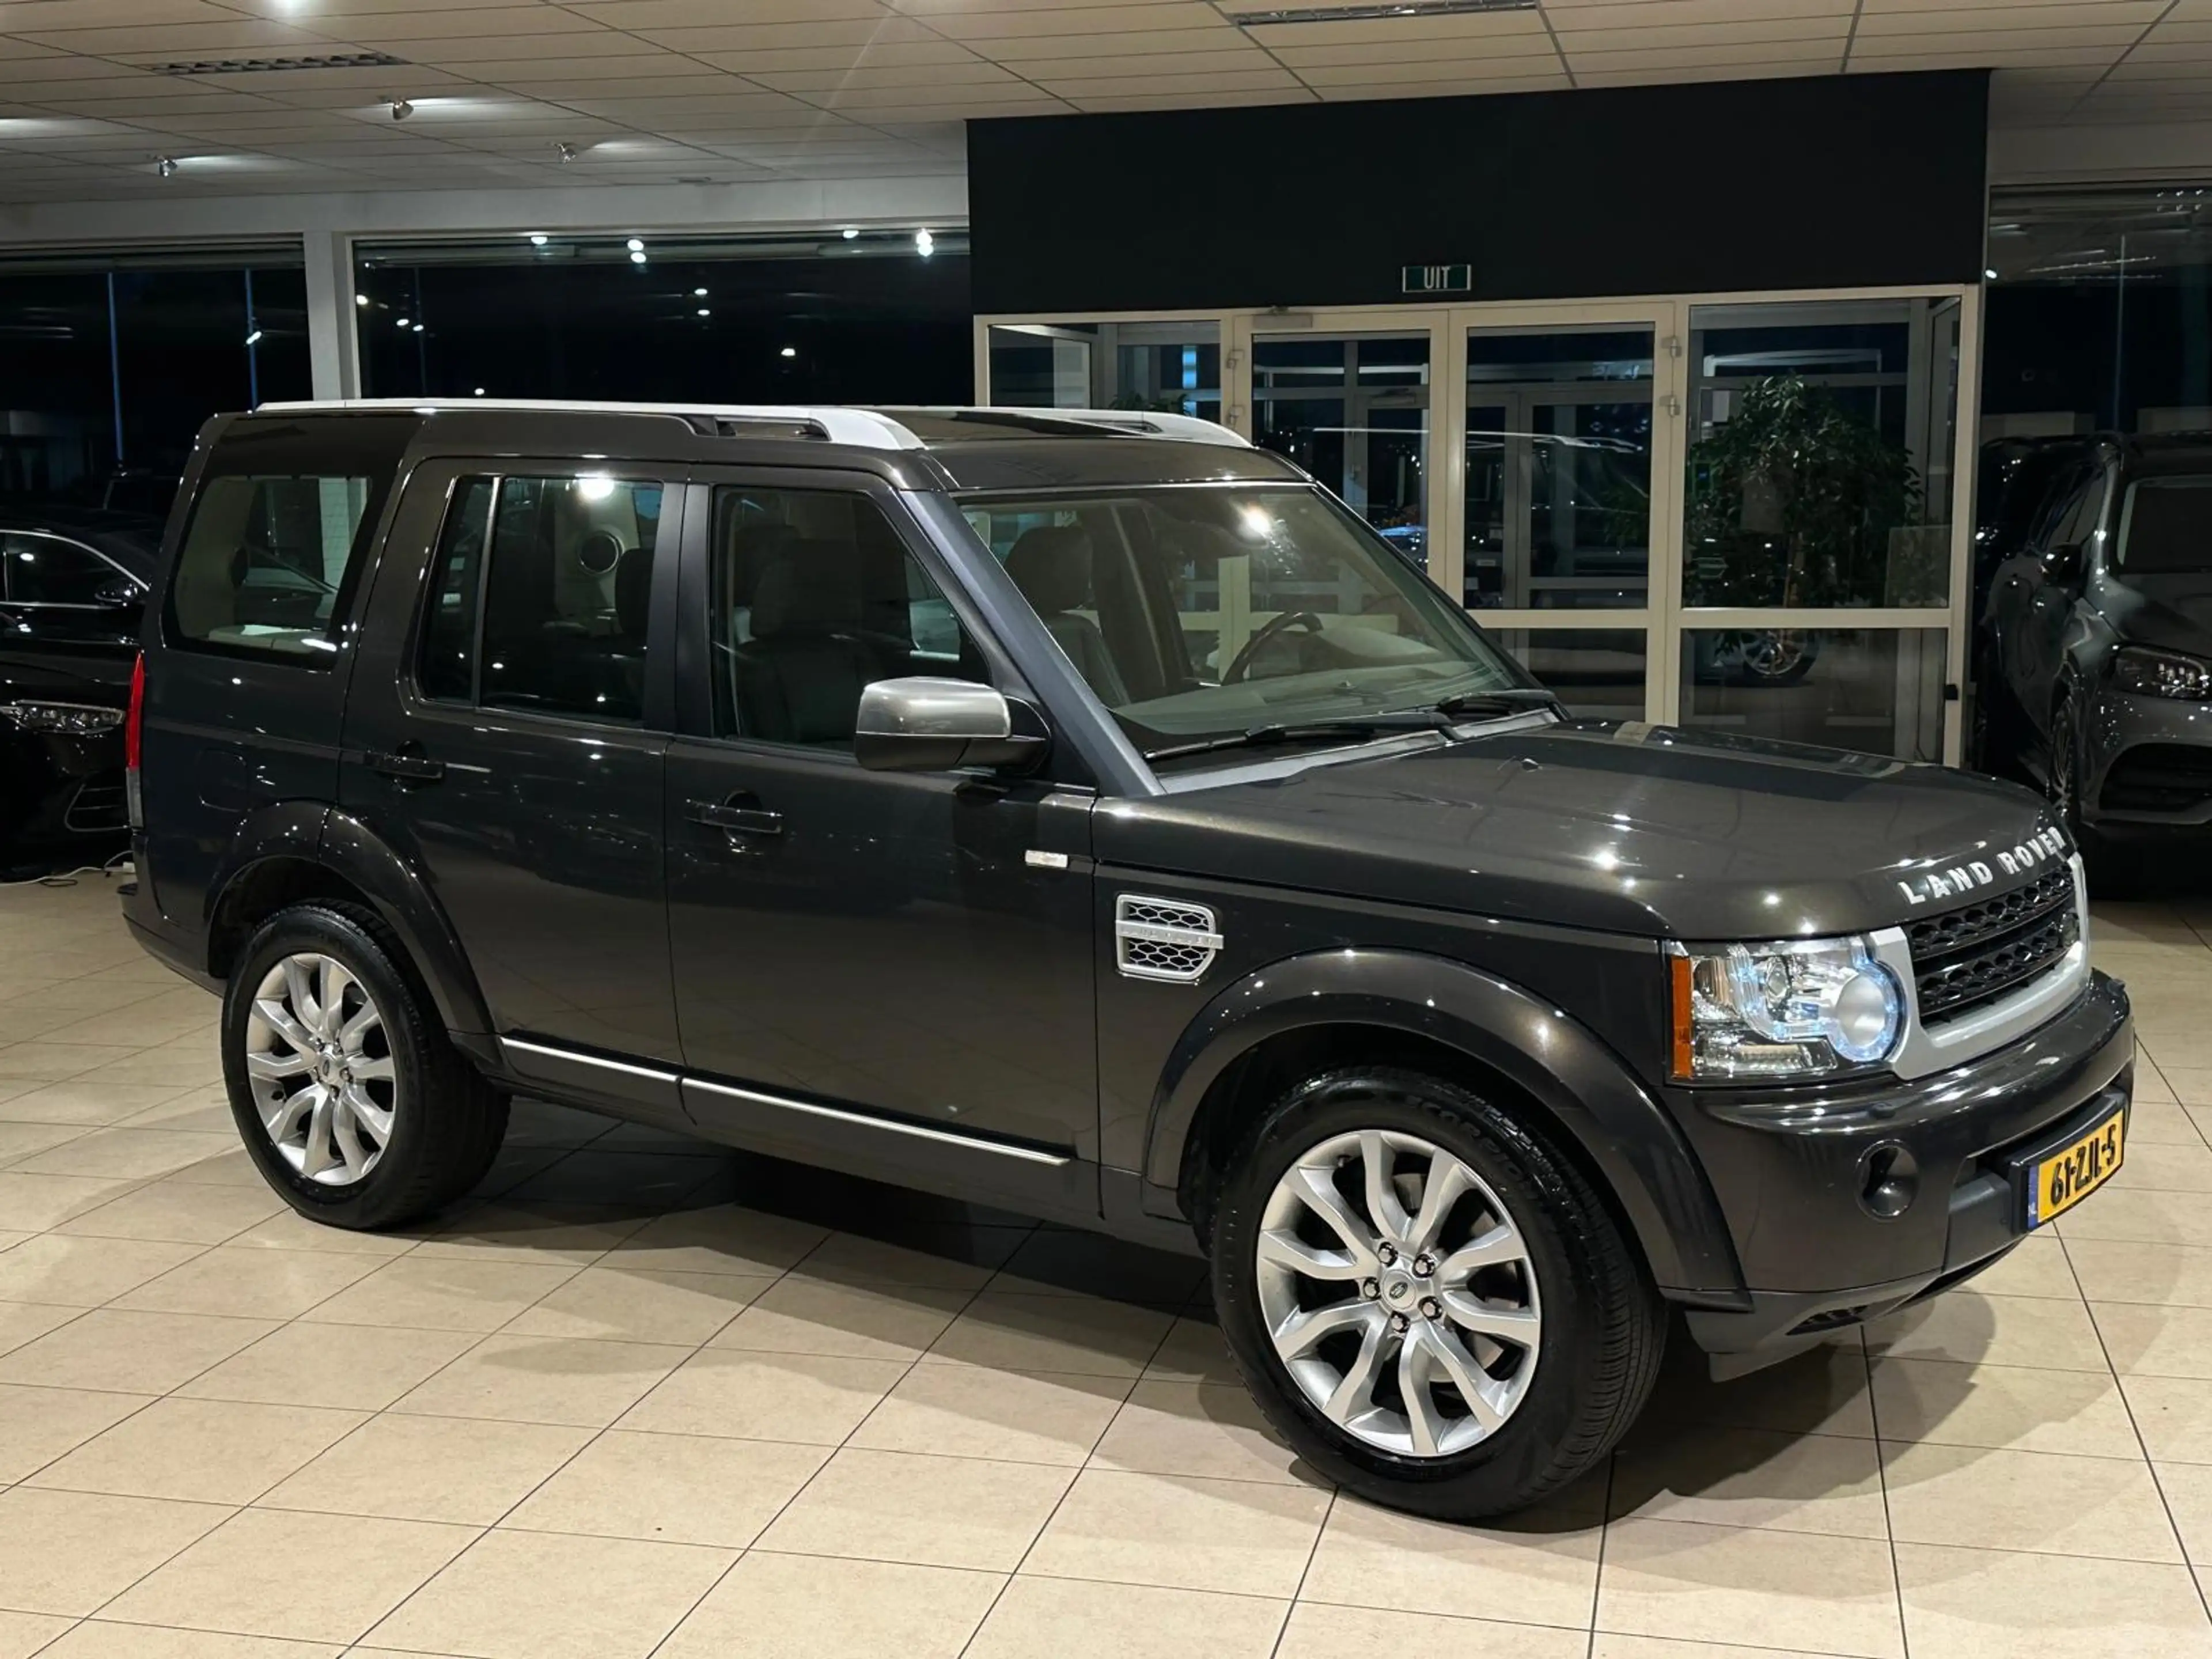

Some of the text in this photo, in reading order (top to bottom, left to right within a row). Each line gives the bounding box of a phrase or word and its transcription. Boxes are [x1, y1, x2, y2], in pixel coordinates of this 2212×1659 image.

[1424, 266, 1451, 290] UIT
[1897, 825, 2067, 906] LAND ROVER
[2050, 1123, 2117, 1207] 61-ZJL-5
